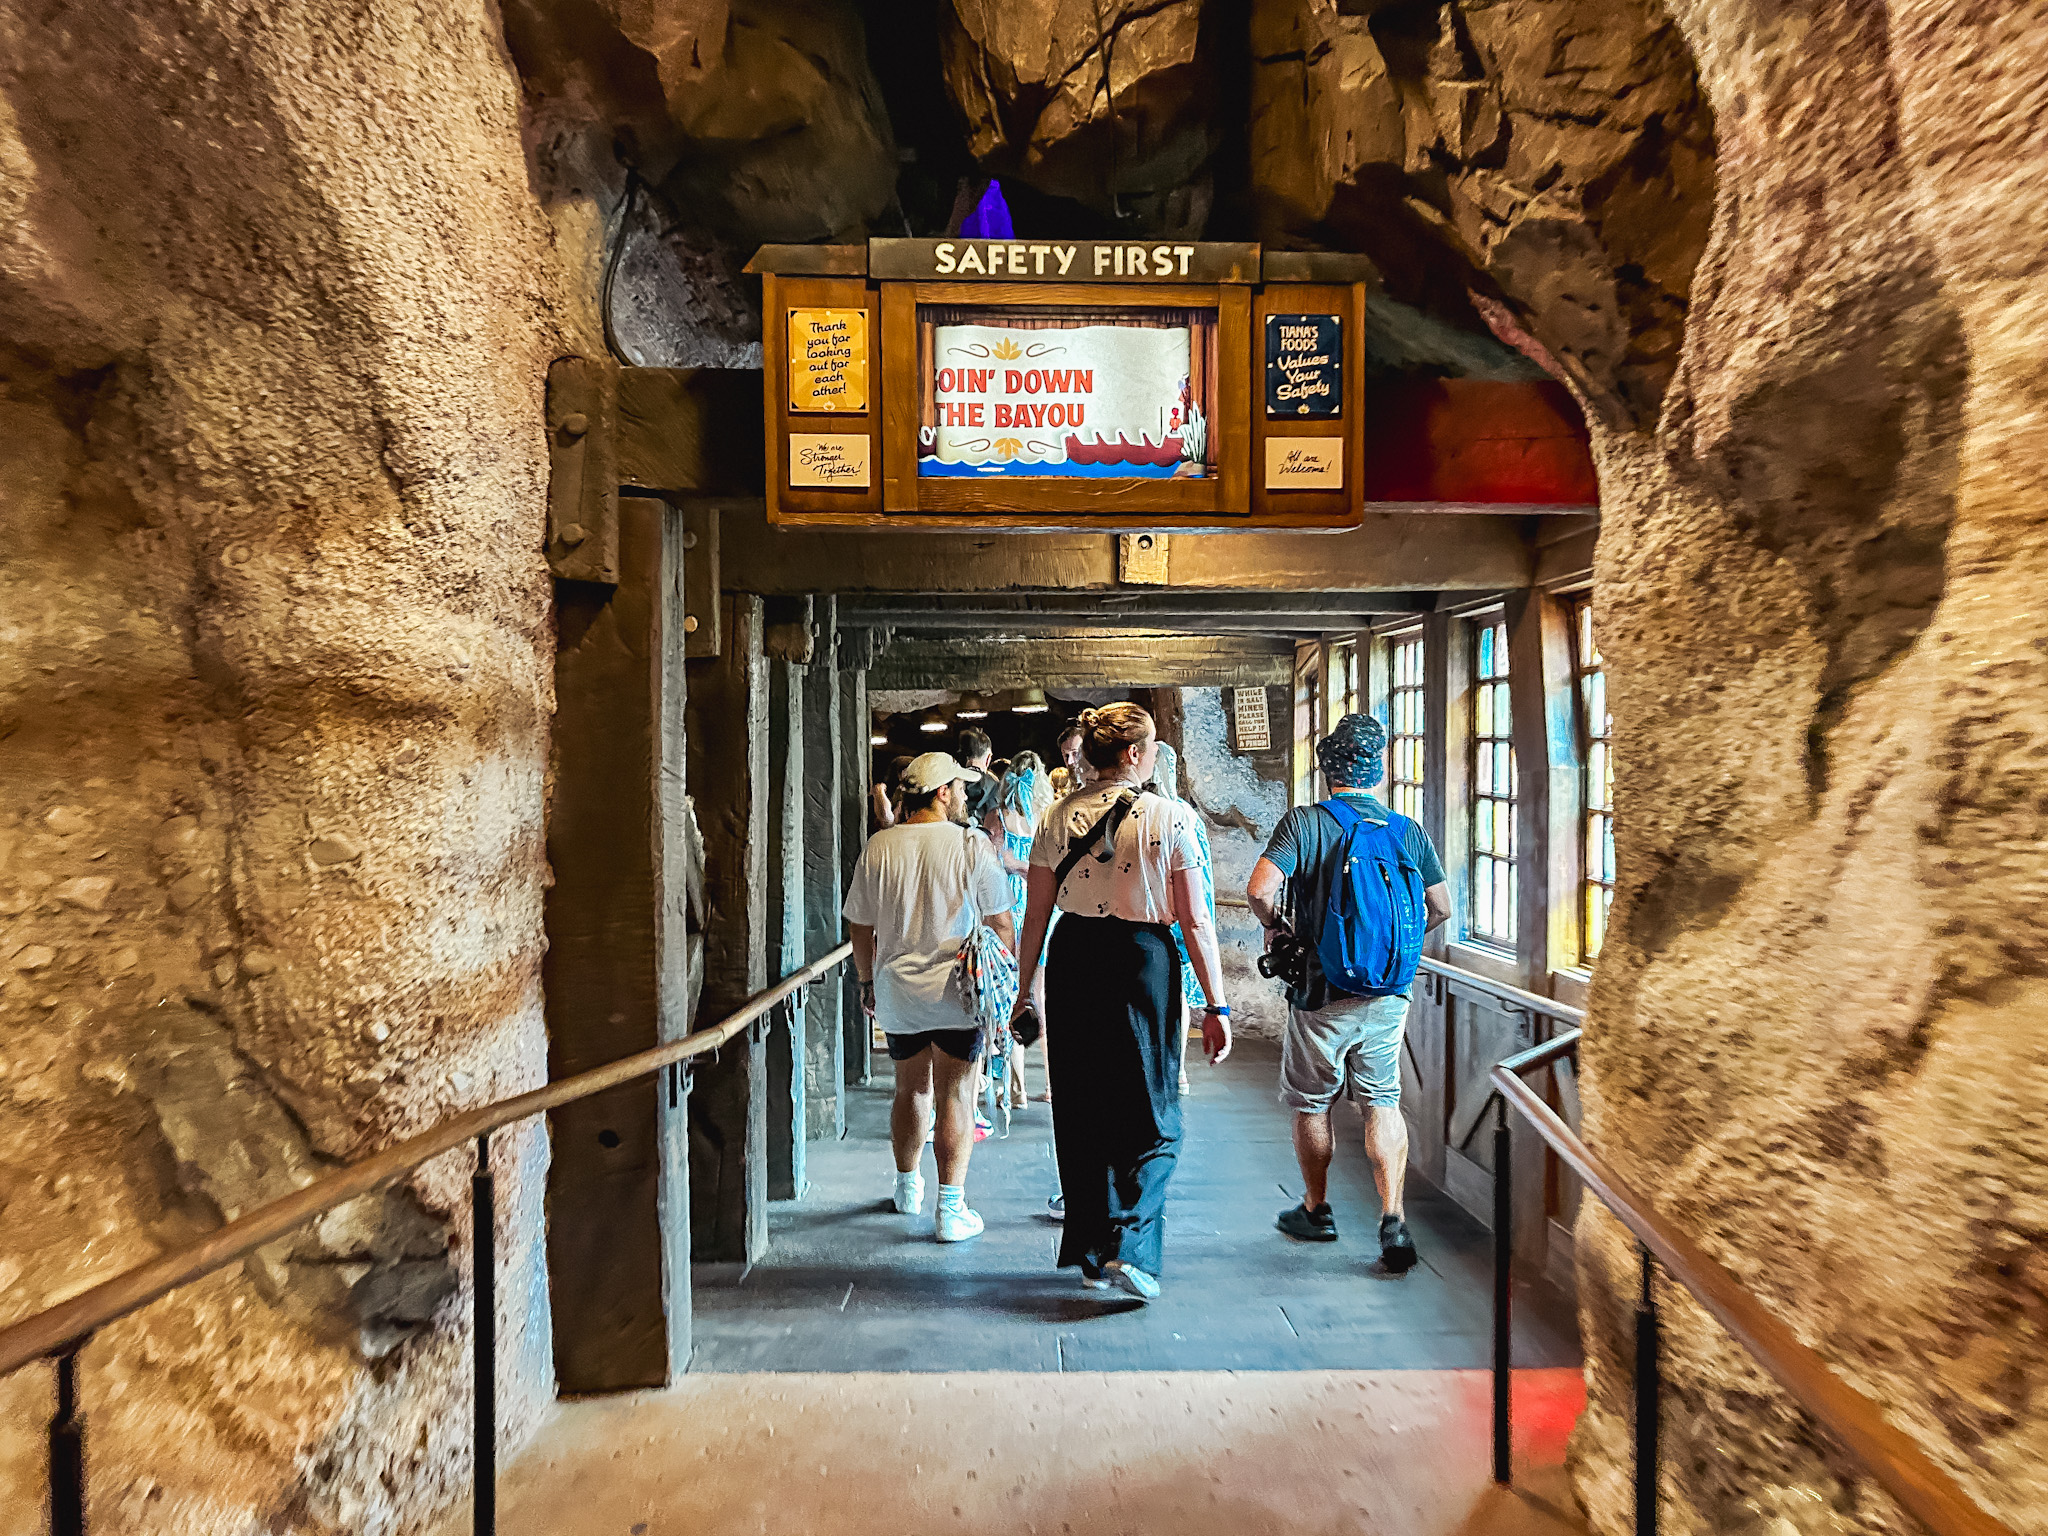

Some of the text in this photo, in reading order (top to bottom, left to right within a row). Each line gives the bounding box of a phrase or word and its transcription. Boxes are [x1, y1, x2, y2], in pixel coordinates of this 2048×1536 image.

[935, 243, 1195, 276] SAFETY FIRST
[809, 320, 847, 333] Thank
[1279, 325, 1319, 338] TIANA'S
[807, 333, 851, 349] you for
[1280, 338, 1318, 351] FOODS
[807, 346, 851, 358] looking
[809, 358, 849, 371] out for
[1277, 352, 1329, 371] Values
[814, 371, 844, 383] each
[934, 367, 1094, 394] OIN' DOWN
[1285, 368, 1321, 384] Your
[812, 382, 847, 396] other!
[1276, 379, 1330, 400] Safety
[935, 402, 1085, 428] THE BAYOU
[816, 442, 830, 451] We
[800, 448, 845, 470] Stronger
[1284, 450, 1302, 463] All
[813, 461, 863, 483] Together!
[1278, 459, 1332, 474] Welcome!
[1237, 689, 1263, 697] WHILE
[1238, 704, 1264, 713] MINES
